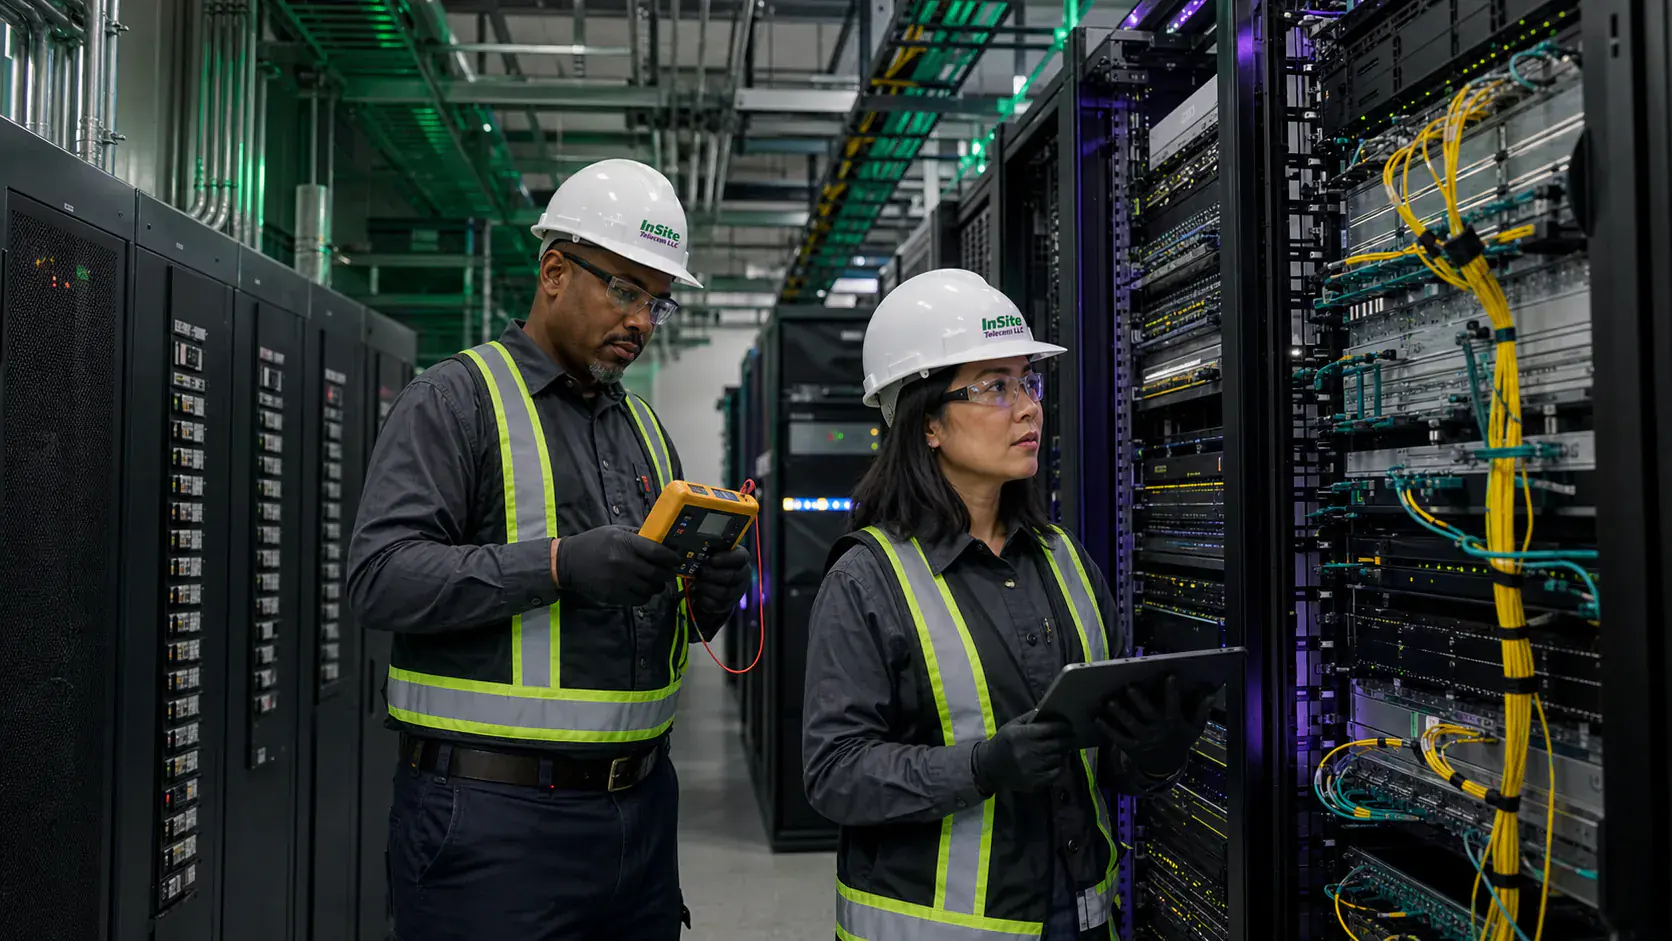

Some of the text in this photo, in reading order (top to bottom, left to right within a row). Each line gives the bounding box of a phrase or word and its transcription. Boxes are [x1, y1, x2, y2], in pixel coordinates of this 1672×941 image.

[640, 219, 680, 242] InSite
[667, 240, 680, 249] LLC
[982, 315, 1022, 331] InSite
